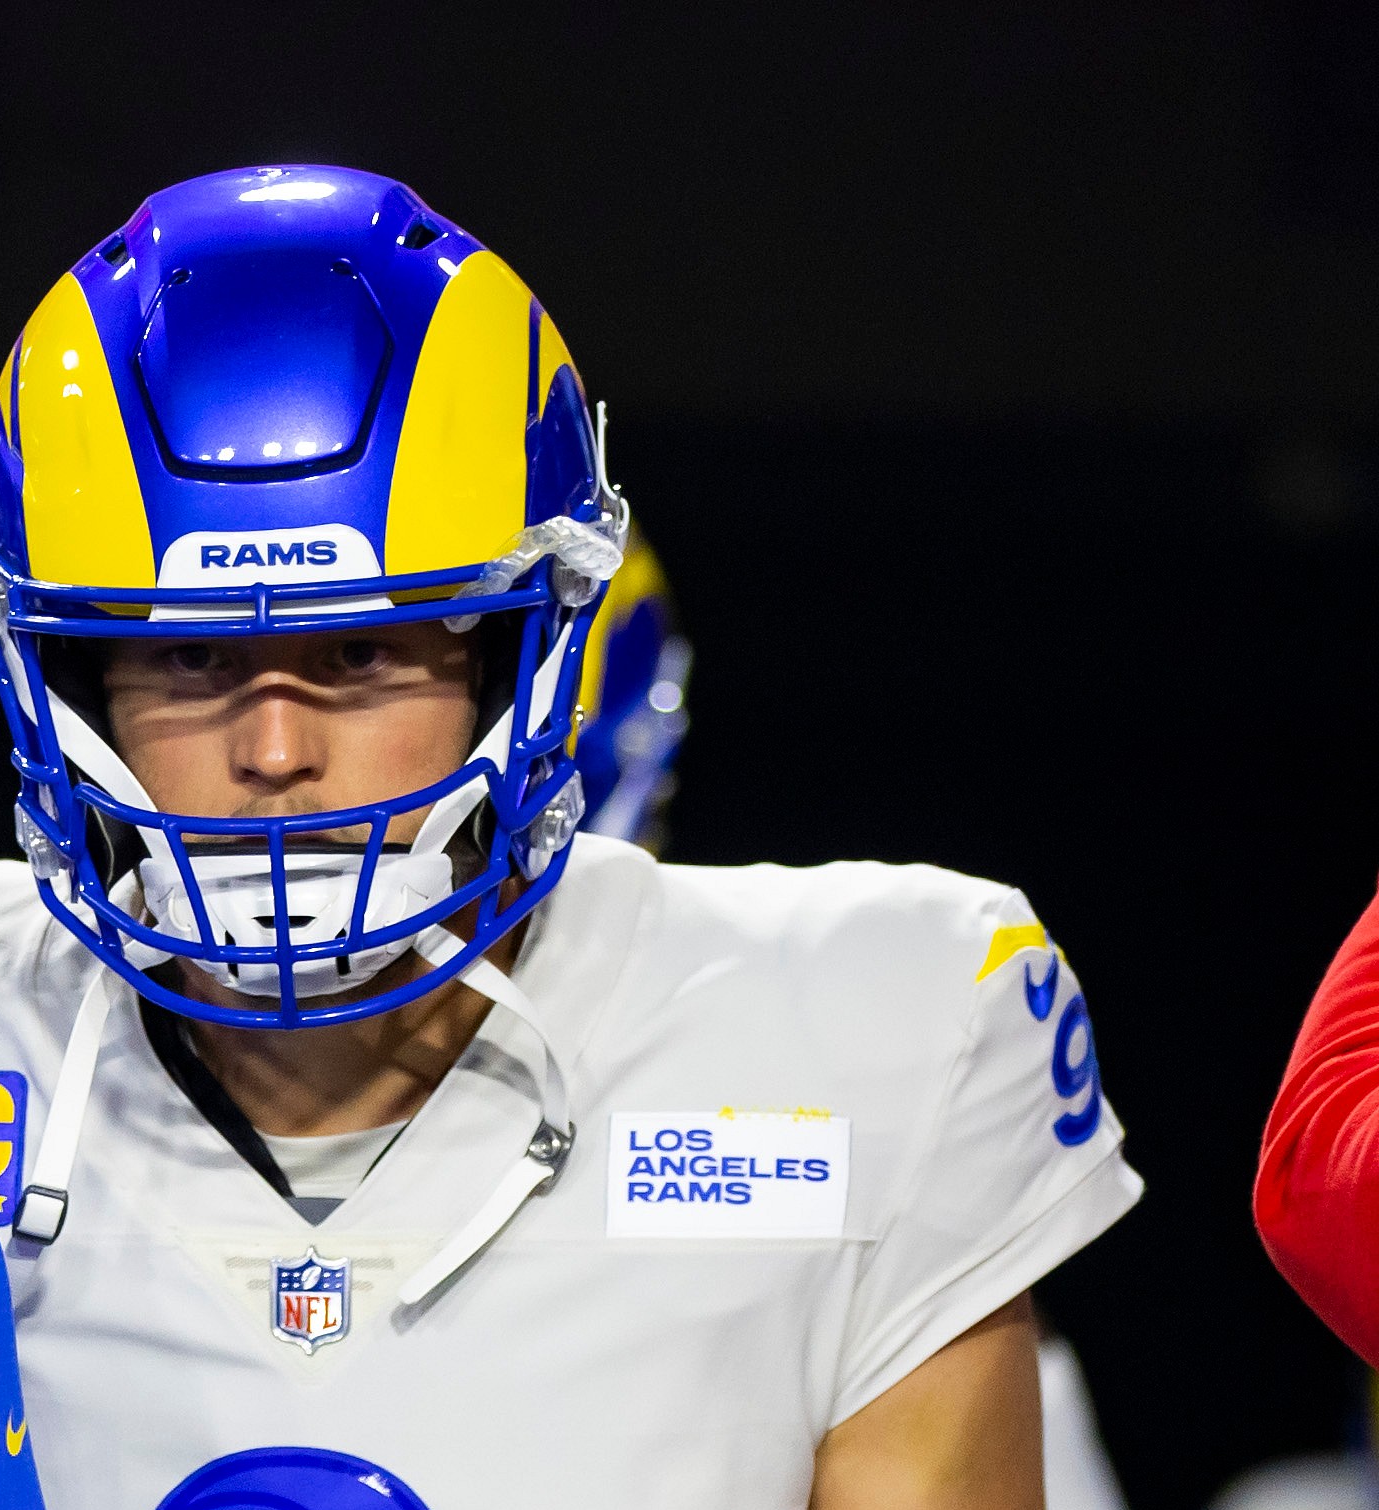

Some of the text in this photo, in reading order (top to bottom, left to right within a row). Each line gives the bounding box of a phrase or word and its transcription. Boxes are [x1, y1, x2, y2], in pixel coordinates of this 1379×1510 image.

[200, 540, 338, 569] RAMS
[1052, 992, 1101, 1147] 9
[629, 1129, 713, 1151] LOS
[627, 1156, 830, 1182] ANGELES
[627, 1182, 752, 1205] RAMS
[284, 1295, 337, 1334] NFL
